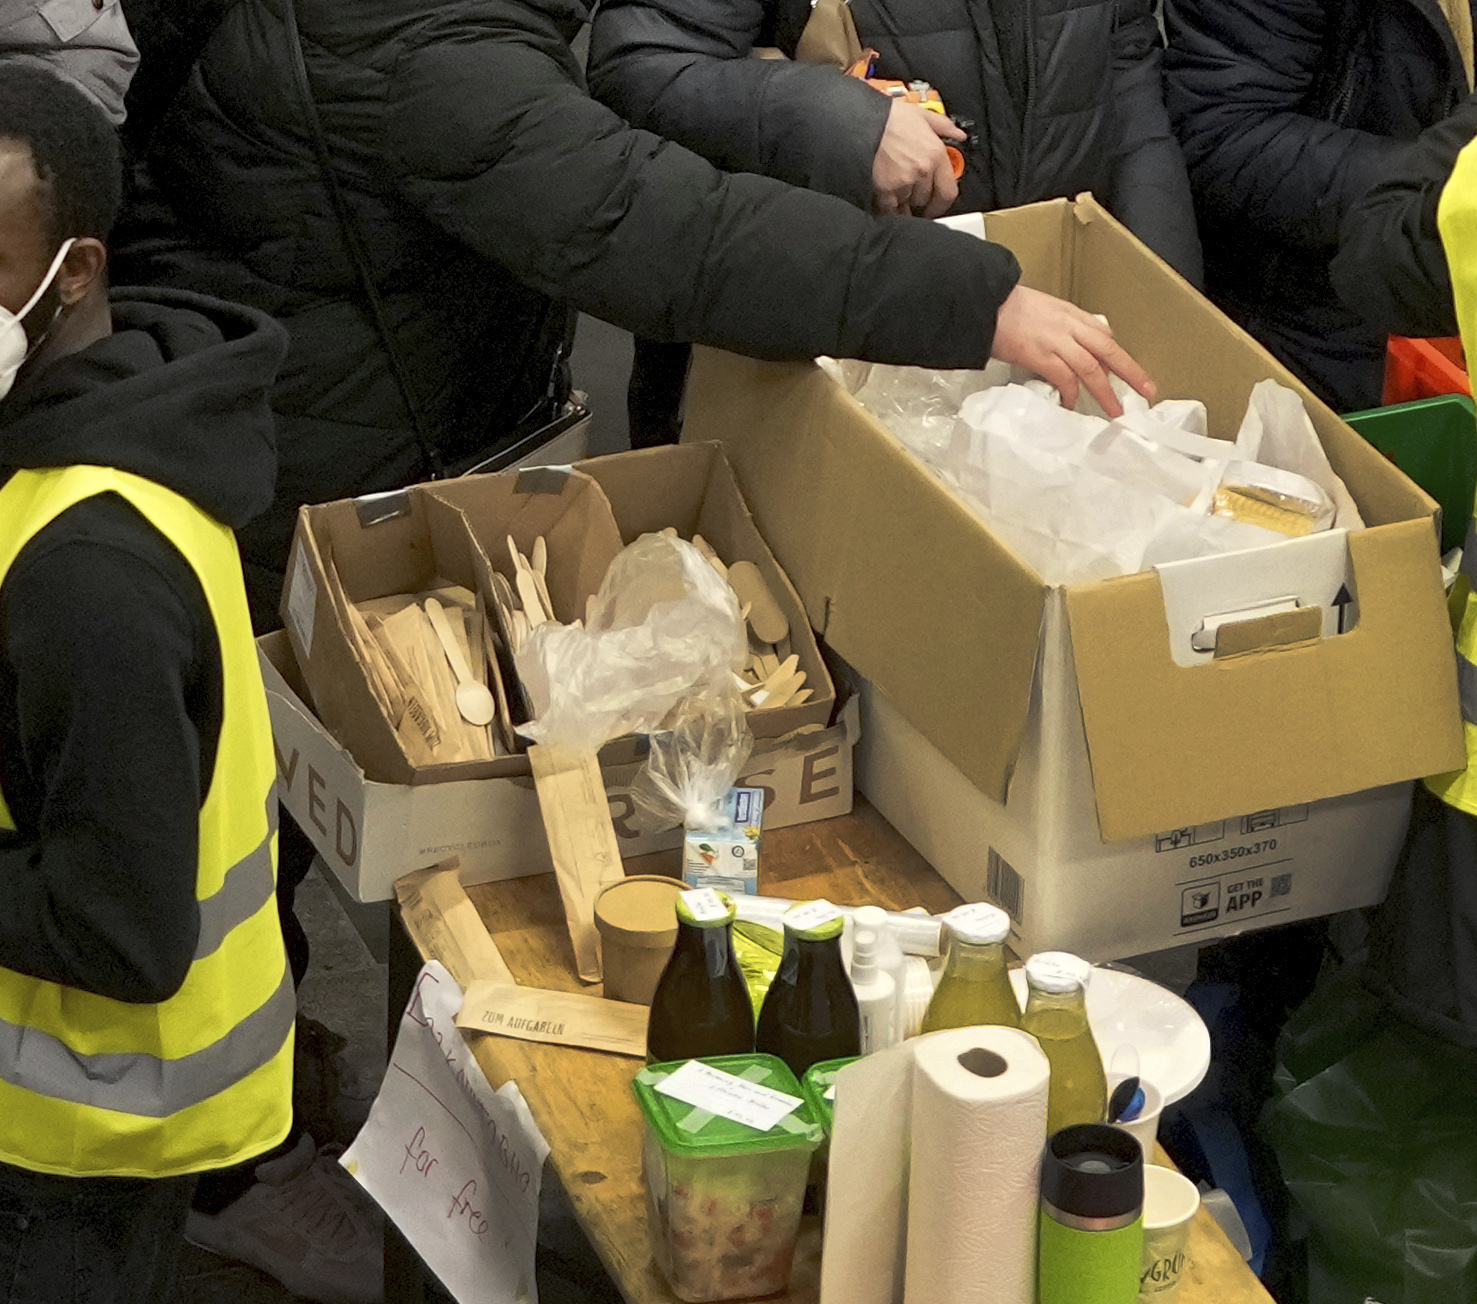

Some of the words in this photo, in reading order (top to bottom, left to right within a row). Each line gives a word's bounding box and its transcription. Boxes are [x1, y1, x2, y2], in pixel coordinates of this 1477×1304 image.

[1188, 838, 1278, 869] 650x350x370
[1226, 881, 1245, 895] GET
[1246, 876, 1265, 891] THE
[1225, 890, 1263, 915] APP
[481, 1010, 504, 1026] ZUM
[398, 1125, 440, 1179] for
[446, 1177, 491, 1237] free
